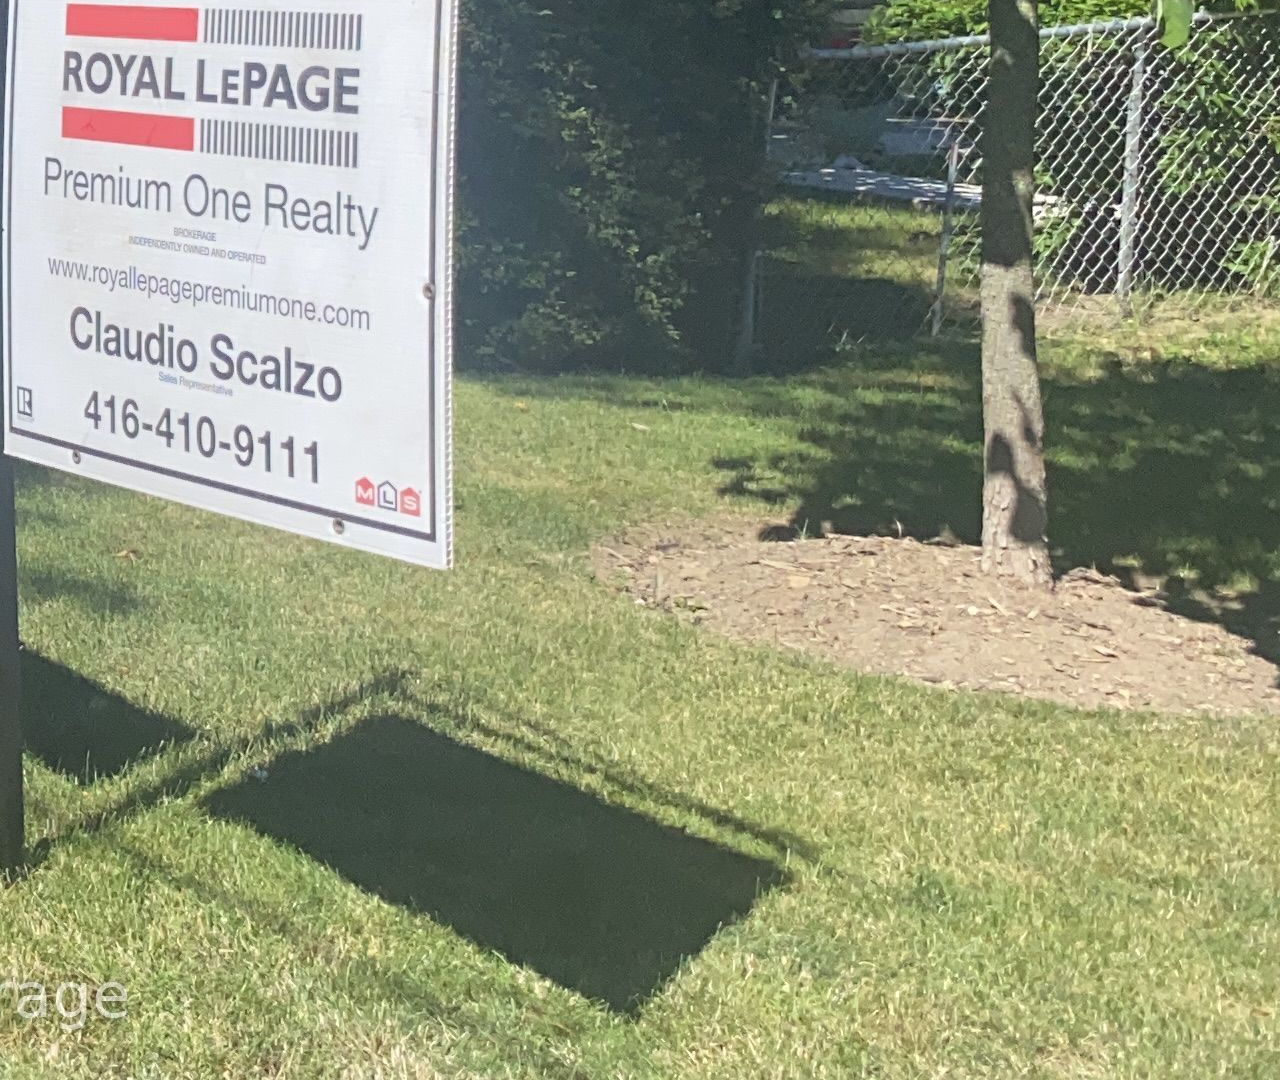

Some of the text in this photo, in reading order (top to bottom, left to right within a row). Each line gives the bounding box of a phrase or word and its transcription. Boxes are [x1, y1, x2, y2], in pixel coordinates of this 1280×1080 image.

[62, 50, 186, 101] ROYAL
[43, 156, 380, 252] Premium One Realty
[173, 226, 217, 242] BROKERAGE
[128, 235, 267, 265] INDEPENDENTLY OWNED AND OPERATED
[47, 257, 371, 331] www.royallepagepremiumone.com
[69, 305, 343, 403] Claudio Scalzo
[158, 370, 234, 397] Sales Representative
[83, 390, 319, 484] 416-410-9111
